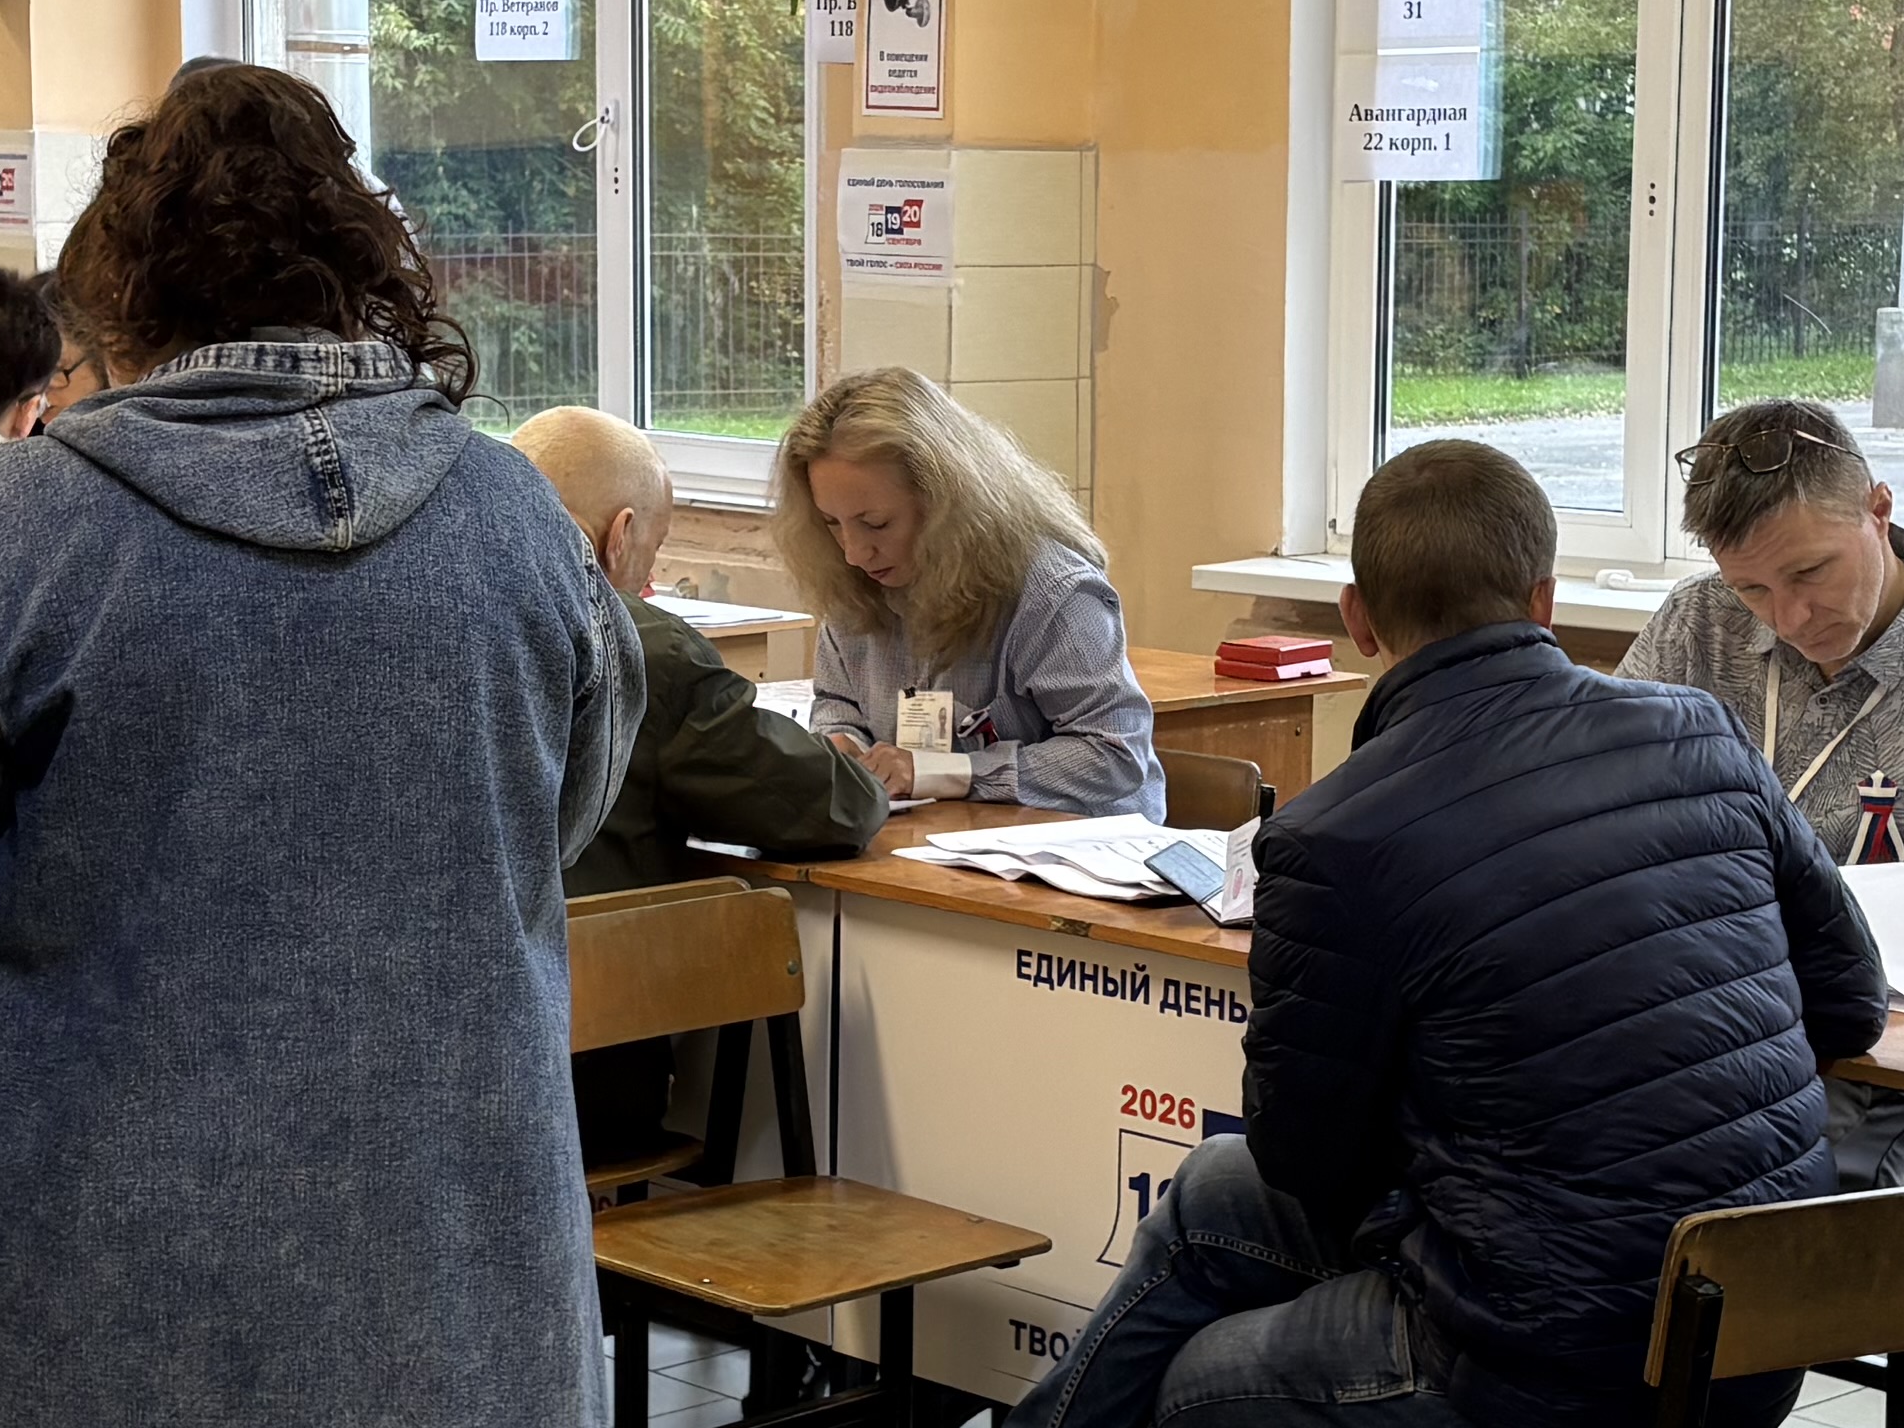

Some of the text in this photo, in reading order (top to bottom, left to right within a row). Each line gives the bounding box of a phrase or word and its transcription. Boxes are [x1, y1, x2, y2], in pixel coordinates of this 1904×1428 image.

[1403, 1, 1423, 20] 31
[489, 21, 549, 40] 118 корп. 2
[830, 20, 854, 37] 118
[1349, 103, 1468, 126] Авангардная
[1362, 132, 1452, 156] 22 корп. 1
[870, 222, 884, 237] 18
[886, 213, 901, 229] 19
[902, 205, 920, 222] 20
[1016, 948, 1248, 1025] ЕДИНЫЙ ДЕНЬ
[1119, 1083, 1196, 1130] 2026
[1128, 1172, 1174, 1223] 1
[1008, 1318, 1081, 1363] ТВО
